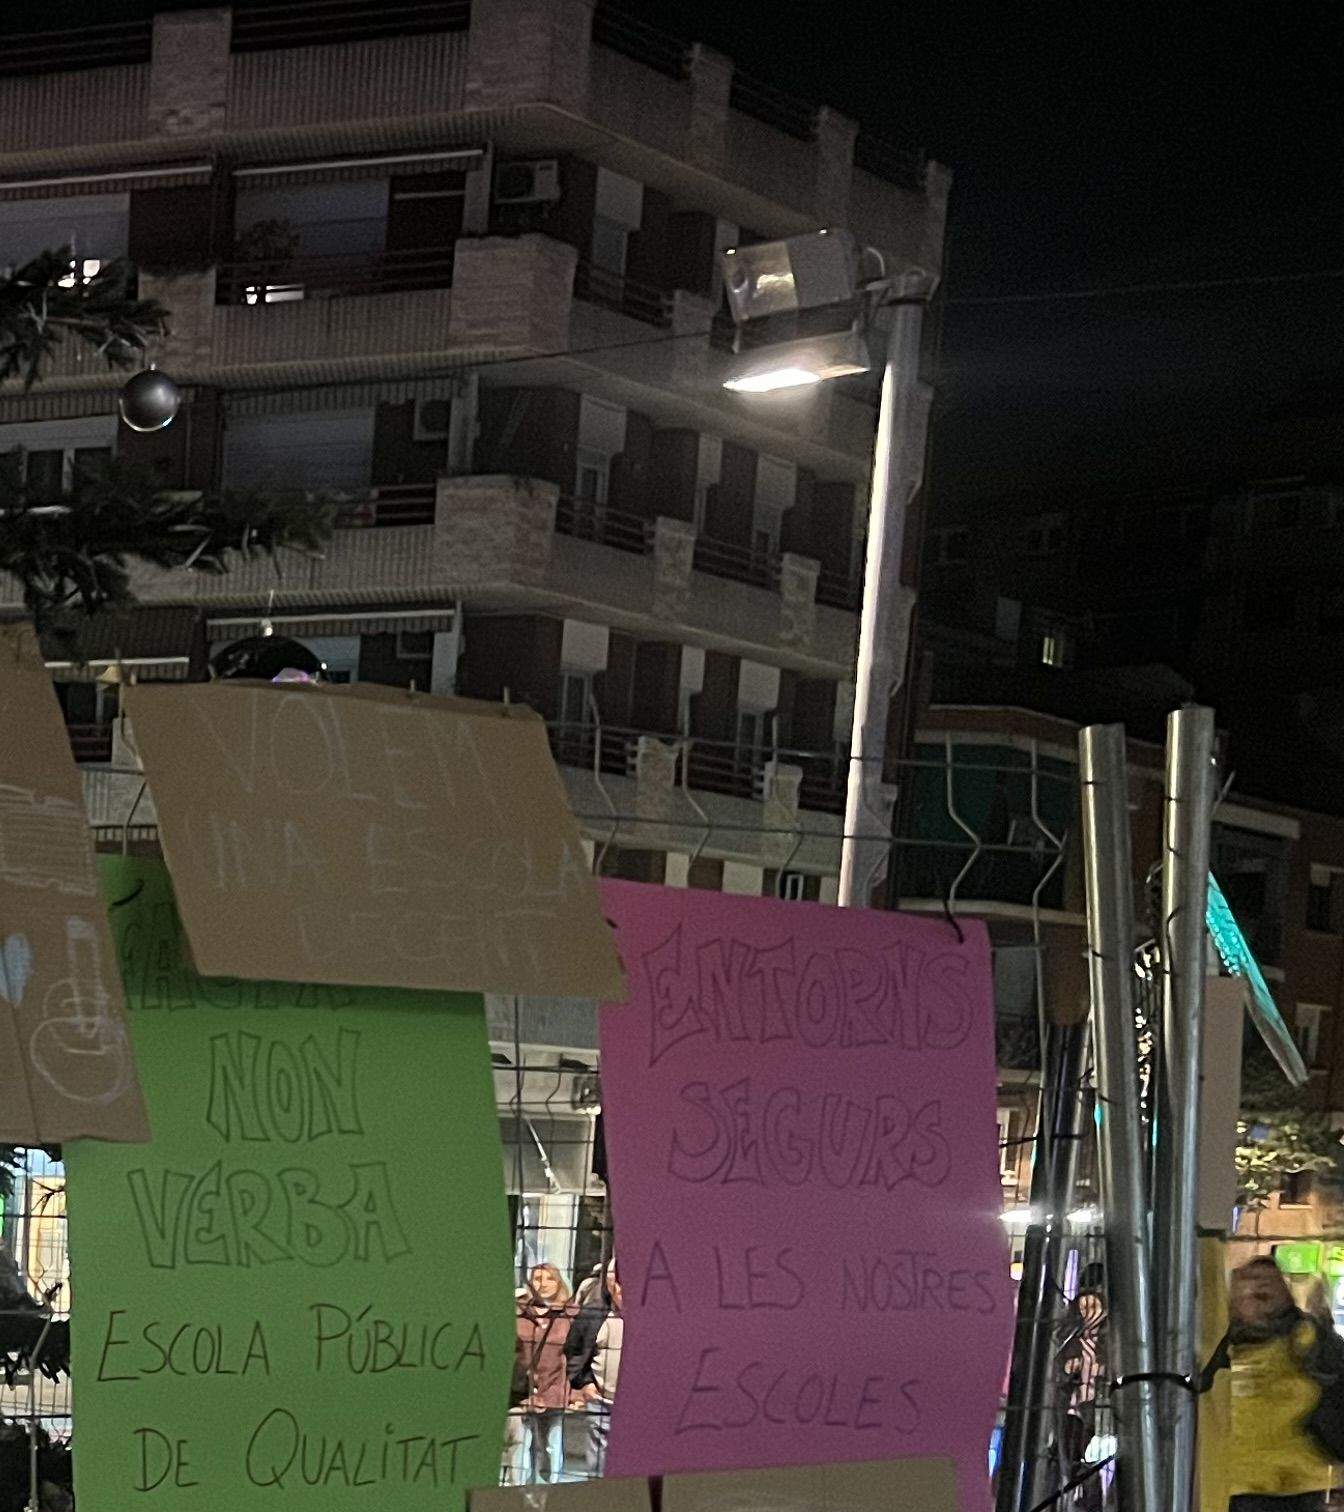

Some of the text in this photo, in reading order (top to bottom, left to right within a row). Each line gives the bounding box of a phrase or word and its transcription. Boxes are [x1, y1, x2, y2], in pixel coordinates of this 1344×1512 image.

[641, 922, 975, 1069] ENTORNS
[205, 1024, 364, 1144] NON
[667, 1078, 953, 1192] SEGURS
[640, 1239, 998, 1315] A LES NOSTRES
[96, 1302, 486, 1383] ESCOLA PÚBLICA
[673, 1345, 923, 1437] ESCOLES
[132, 1406, 482, 1493] DE QUALITAT
